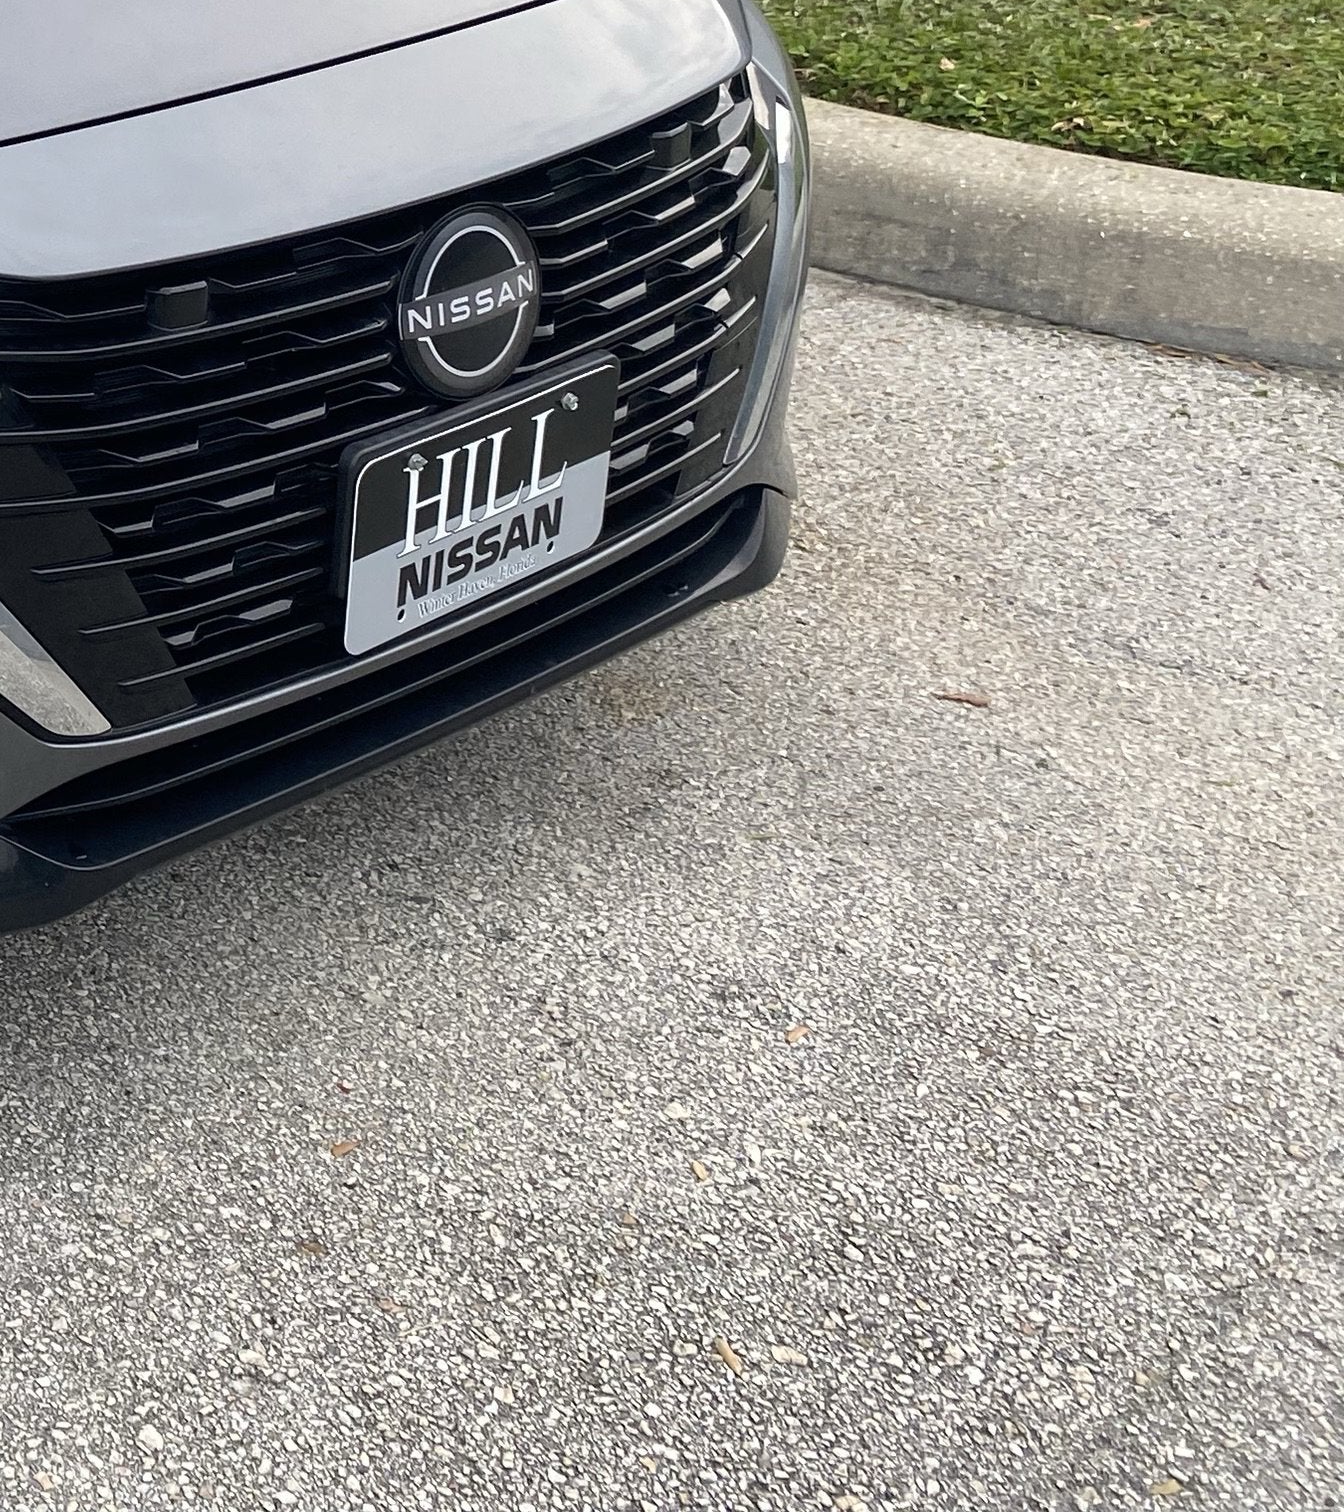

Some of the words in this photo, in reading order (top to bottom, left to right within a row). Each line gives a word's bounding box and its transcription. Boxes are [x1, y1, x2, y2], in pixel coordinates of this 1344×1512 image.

[407, 268, 534, 333] NISSAN
[396, 408, 568, 559] HILL
[396, 495, 564, 608] NISSAN
[417, 591, 457, 619] Winter
[457, 574, 497, 601] Haven,
[497, 552, 537, 583] Florida
